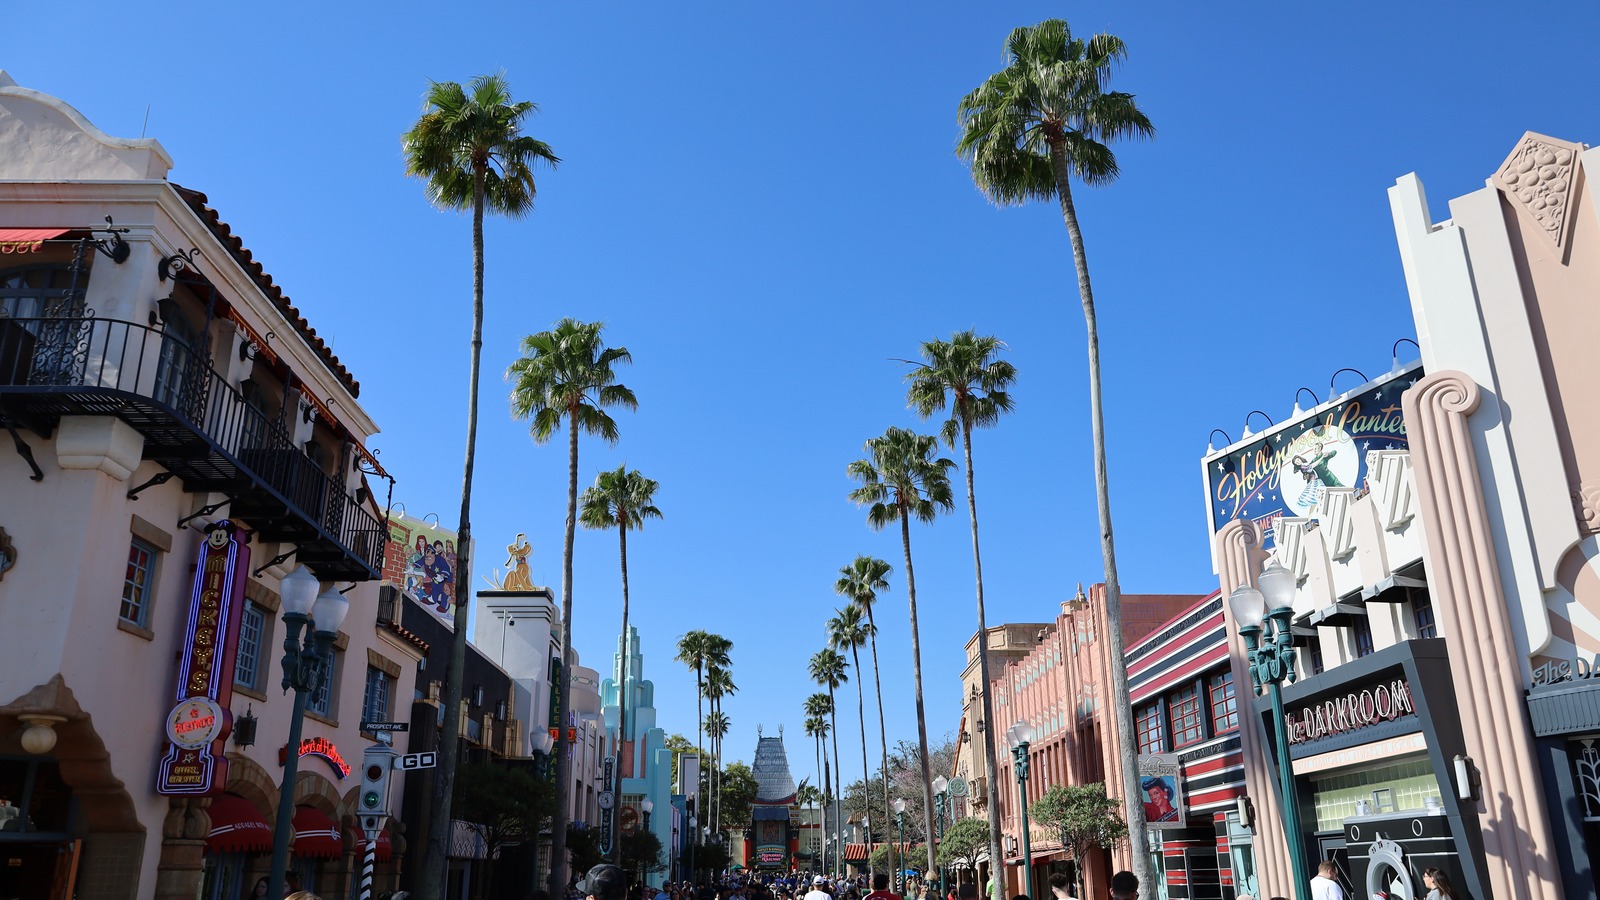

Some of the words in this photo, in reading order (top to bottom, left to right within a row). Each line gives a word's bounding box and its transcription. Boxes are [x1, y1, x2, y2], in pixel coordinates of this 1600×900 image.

[1217, 412, 1335, 519] Hollywood
[1336, 402, 1408, 445] Cantee
[189, 555, 228, 693] MICKEY'S
[1532, 660, 1570, 688] The
[1303, 679, 1412, 738] DARKROOM
[403, 753, 435, 769] GO
